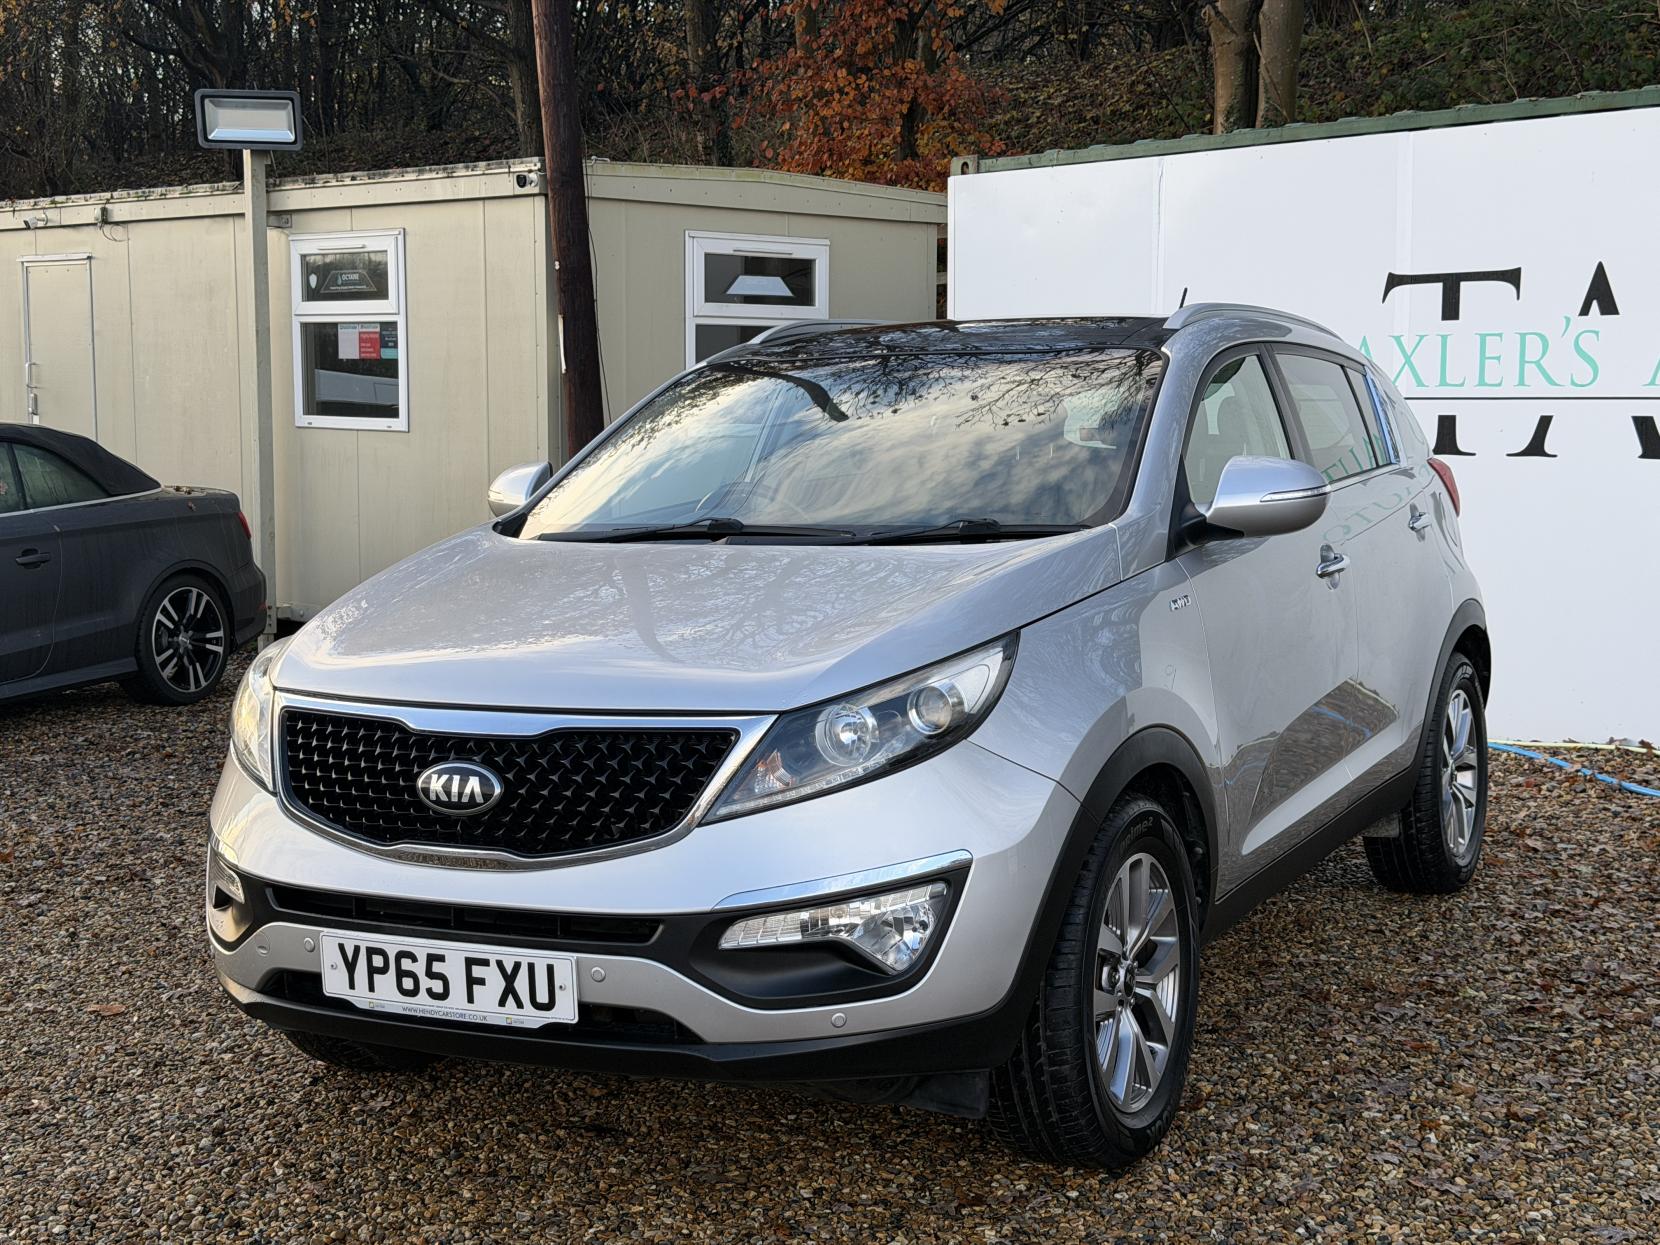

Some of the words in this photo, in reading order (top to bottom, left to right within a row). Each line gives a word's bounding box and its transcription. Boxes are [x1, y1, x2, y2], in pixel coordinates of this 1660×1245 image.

[429, 773, 485, 804] KIA
[337, 942, 451, 1002] YP65
[464, 956, 556, 1012] FXU
